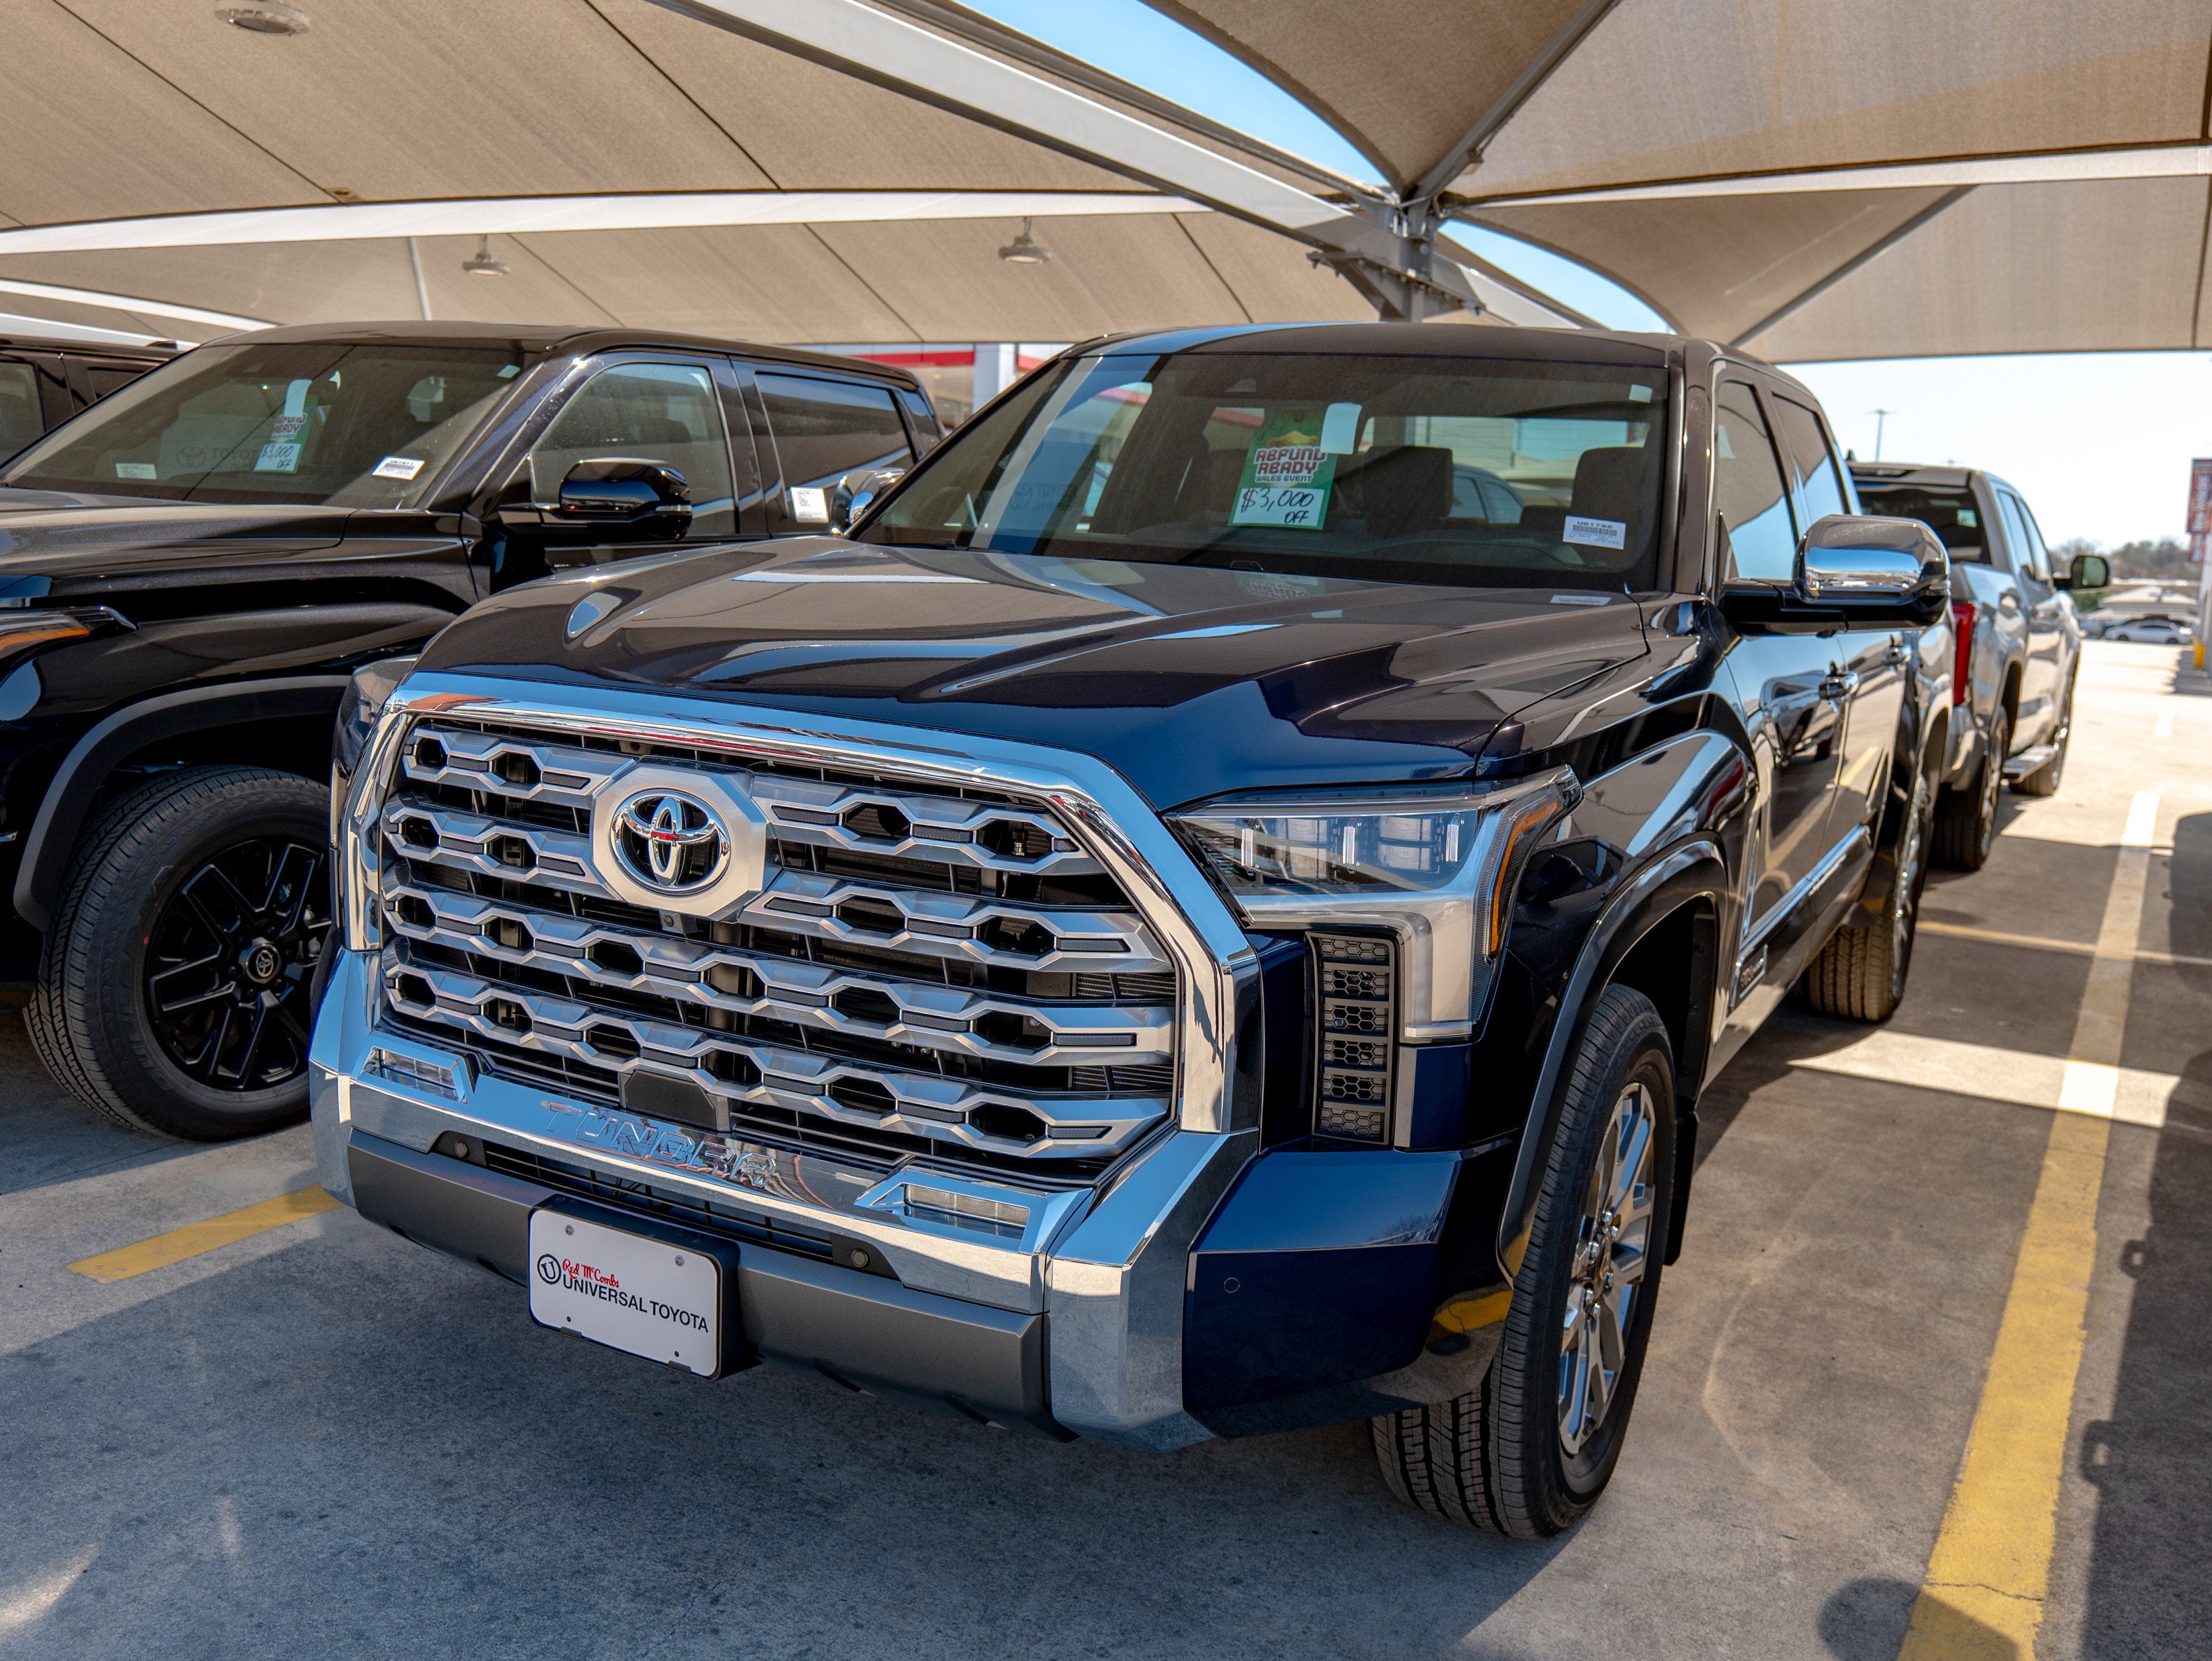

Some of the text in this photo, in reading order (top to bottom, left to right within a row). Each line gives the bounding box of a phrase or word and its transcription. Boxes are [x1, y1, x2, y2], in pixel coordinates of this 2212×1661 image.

[1255, 448, 1327, 461] REFUND
[1257, 461, 1316, 475] READY
[1241, 487, 1314, 513] $3,000
[1284, 510, 1310, 524] OFF
[544, 1100, 777, 1189] TUNDRA
[562, 1258, 620, 1288] Red McCombs
[563, 1274, 709, 1334] UNIVERSAL TOYOTA
